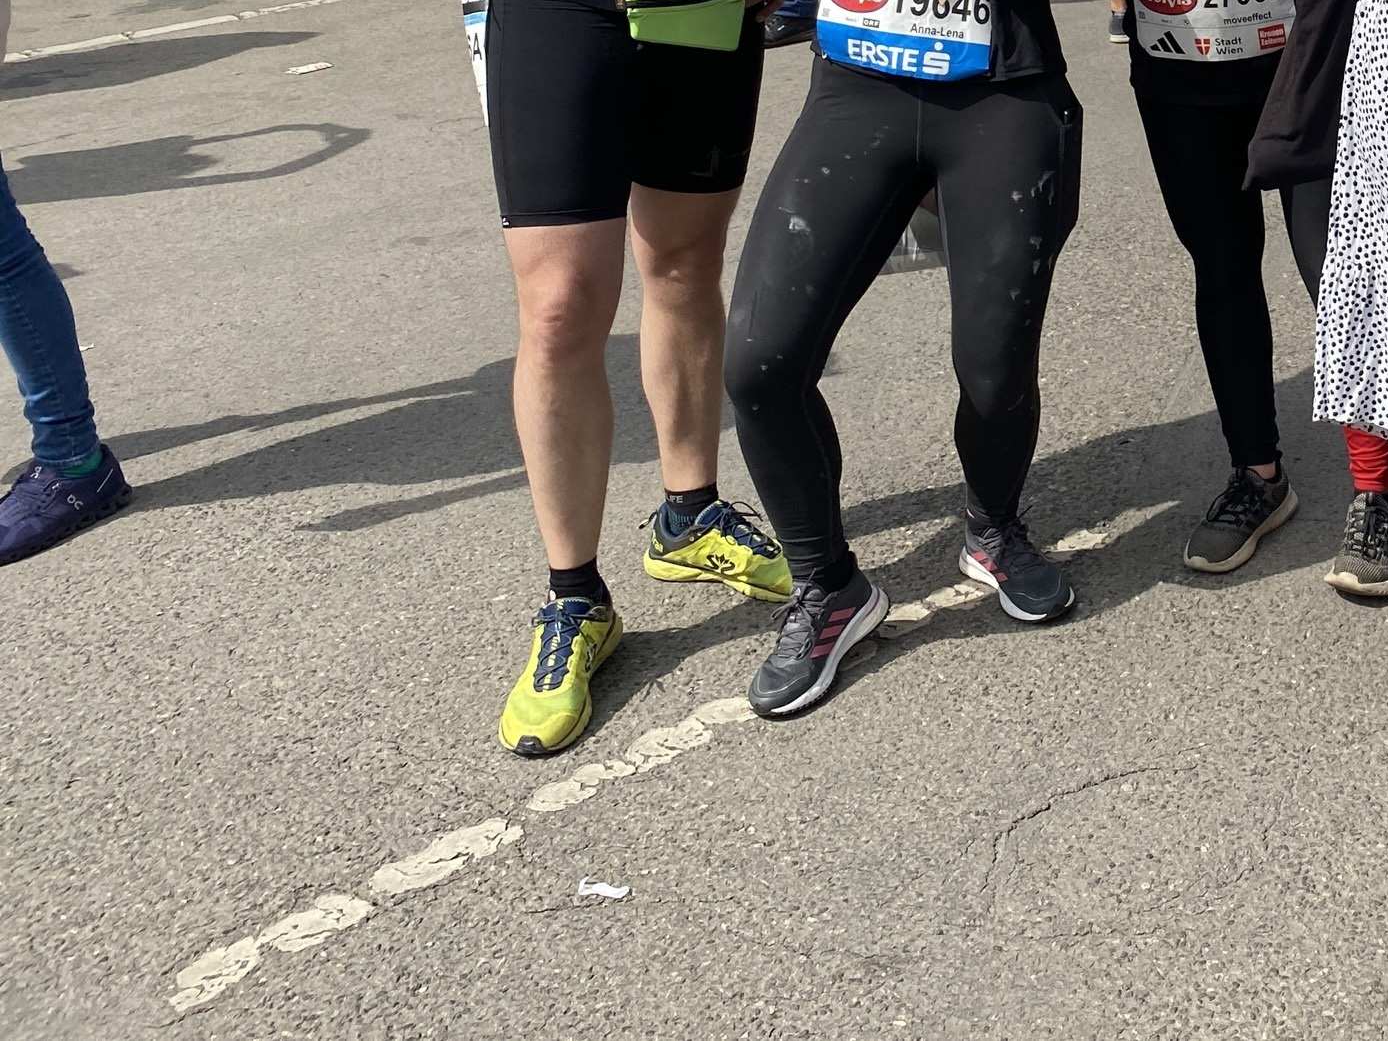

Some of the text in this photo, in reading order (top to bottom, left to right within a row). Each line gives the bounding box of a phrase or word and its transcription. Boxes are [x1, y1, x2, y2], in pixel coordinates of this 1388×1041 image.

[1223, 10, 1272, 26] moveeffect
[909, 22, 965, 39] Anna-Lena
[1215, 37, 1242, 47] Stadt
[847, 38, 920, 72] ERSTE
[1215, 46, 1244, 55] Wien
